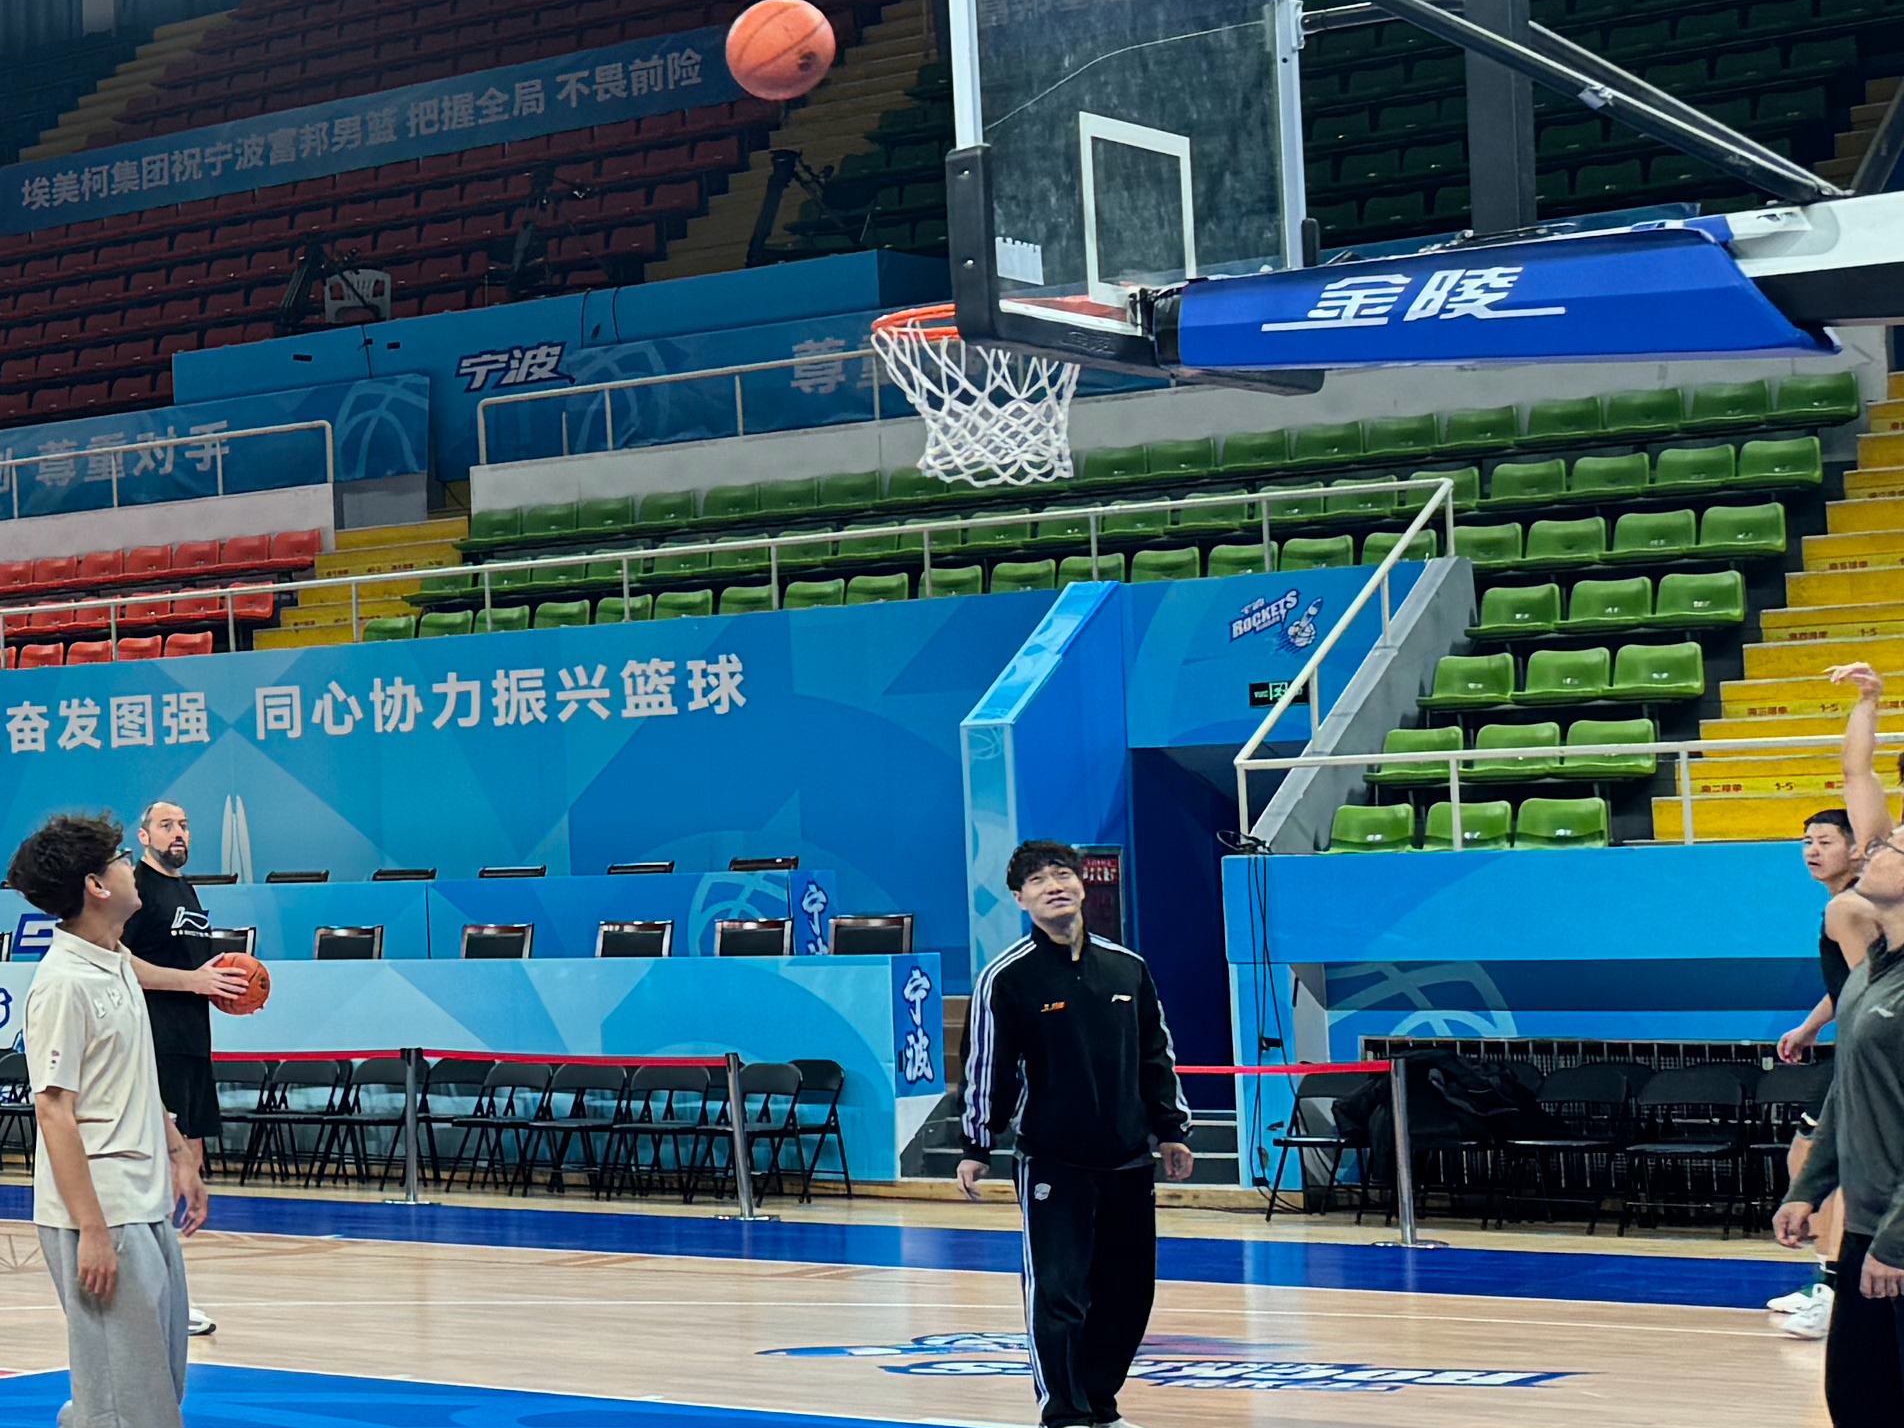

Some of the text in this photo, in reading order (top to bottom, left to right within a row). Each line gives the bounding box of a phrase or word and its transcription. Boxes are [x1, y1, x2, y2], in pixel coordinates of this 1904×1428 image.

[407, 79, 545, 138] 把握全局
[1261, 267, 1566, 332] 金陵
[456, 342, 570, 394] 宁波
[34, 419, 232, 487] 尊重对手
[1229, 589, 1300, 641] ROCKETS
[254, 652, 748, 741] 同心协力振兴篮球
[903, 966, 934, 1083] 宁波
